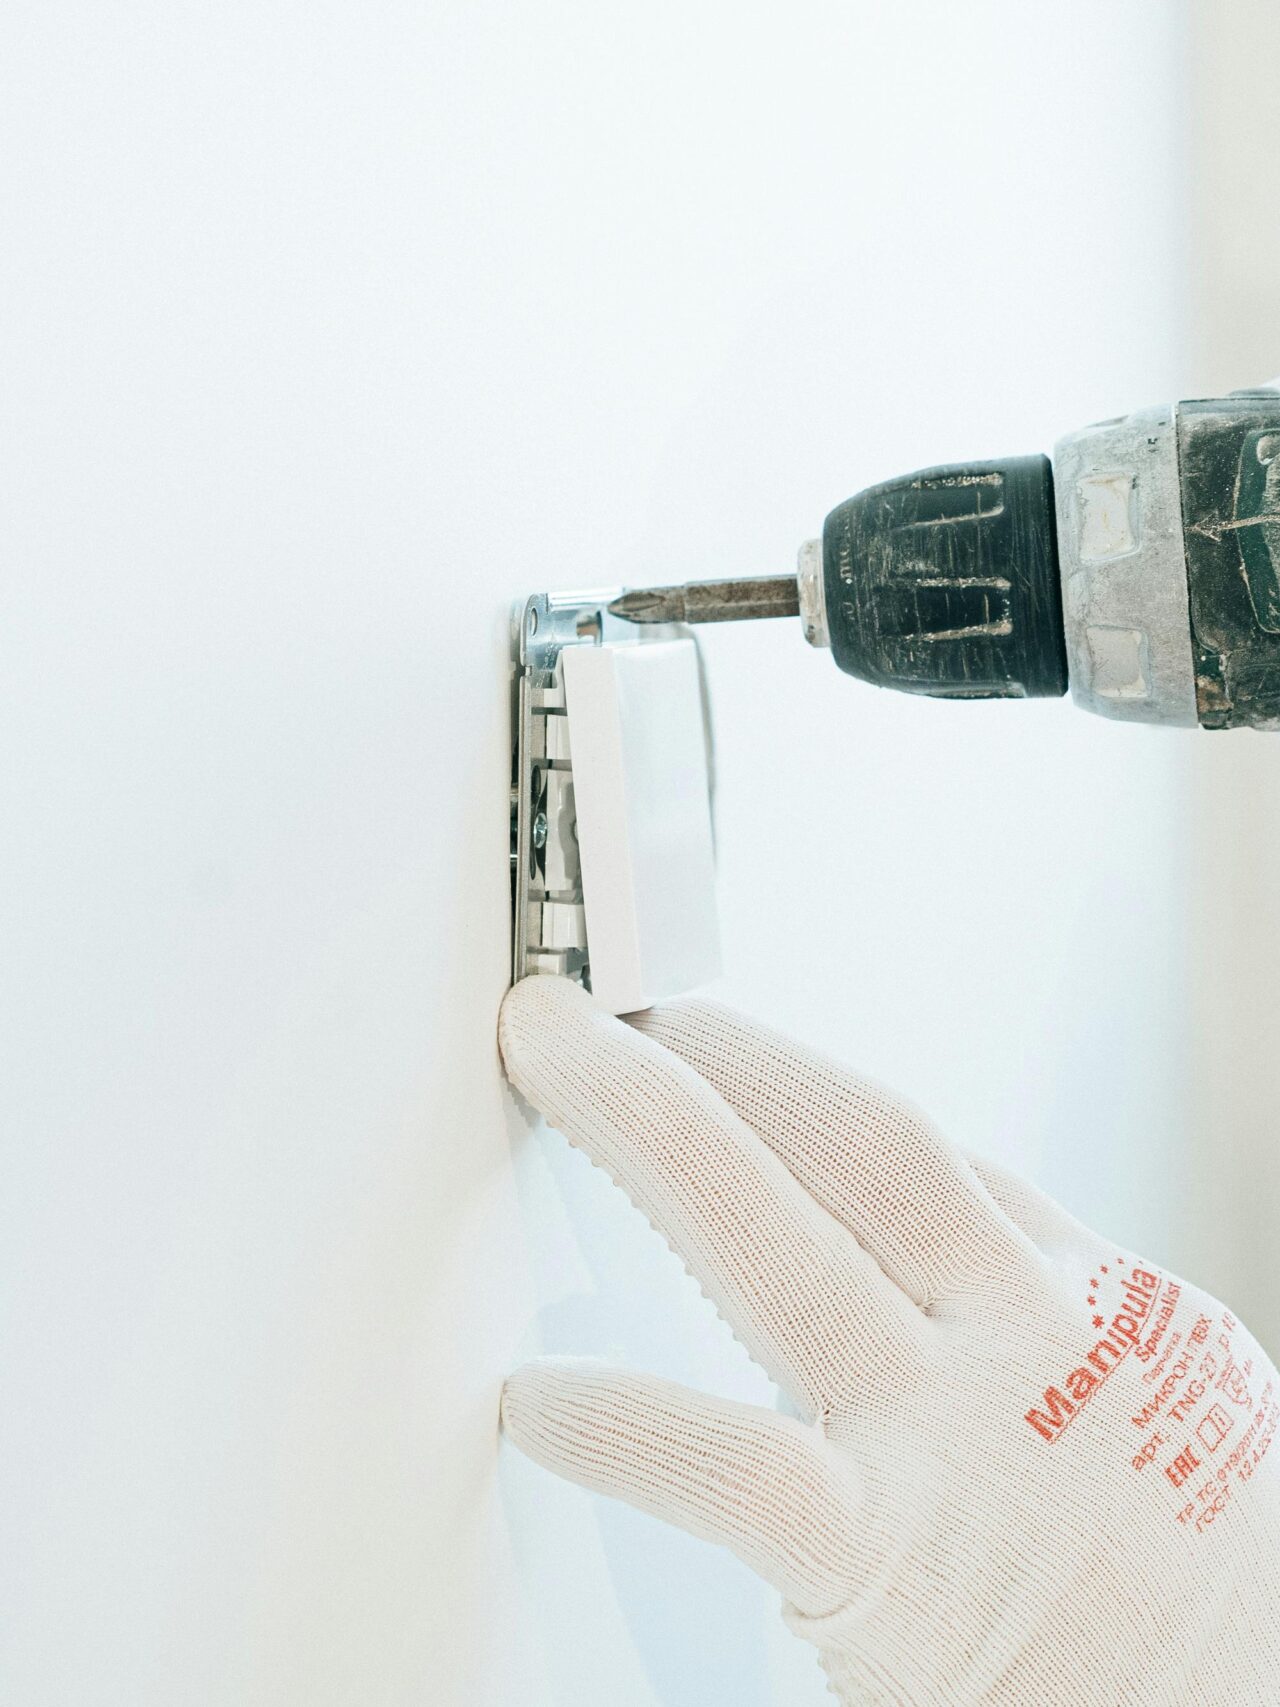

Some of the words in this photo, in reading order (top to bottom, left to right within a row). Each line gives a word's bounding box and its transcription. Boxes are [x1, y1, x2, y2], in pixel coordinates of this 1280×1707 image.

[1024, 1268, 1157, 1442] Manipula
[1135, 1282, 1180, 1362] Specialist
[1131, 1351, 1194, 1428] МИКРОН
